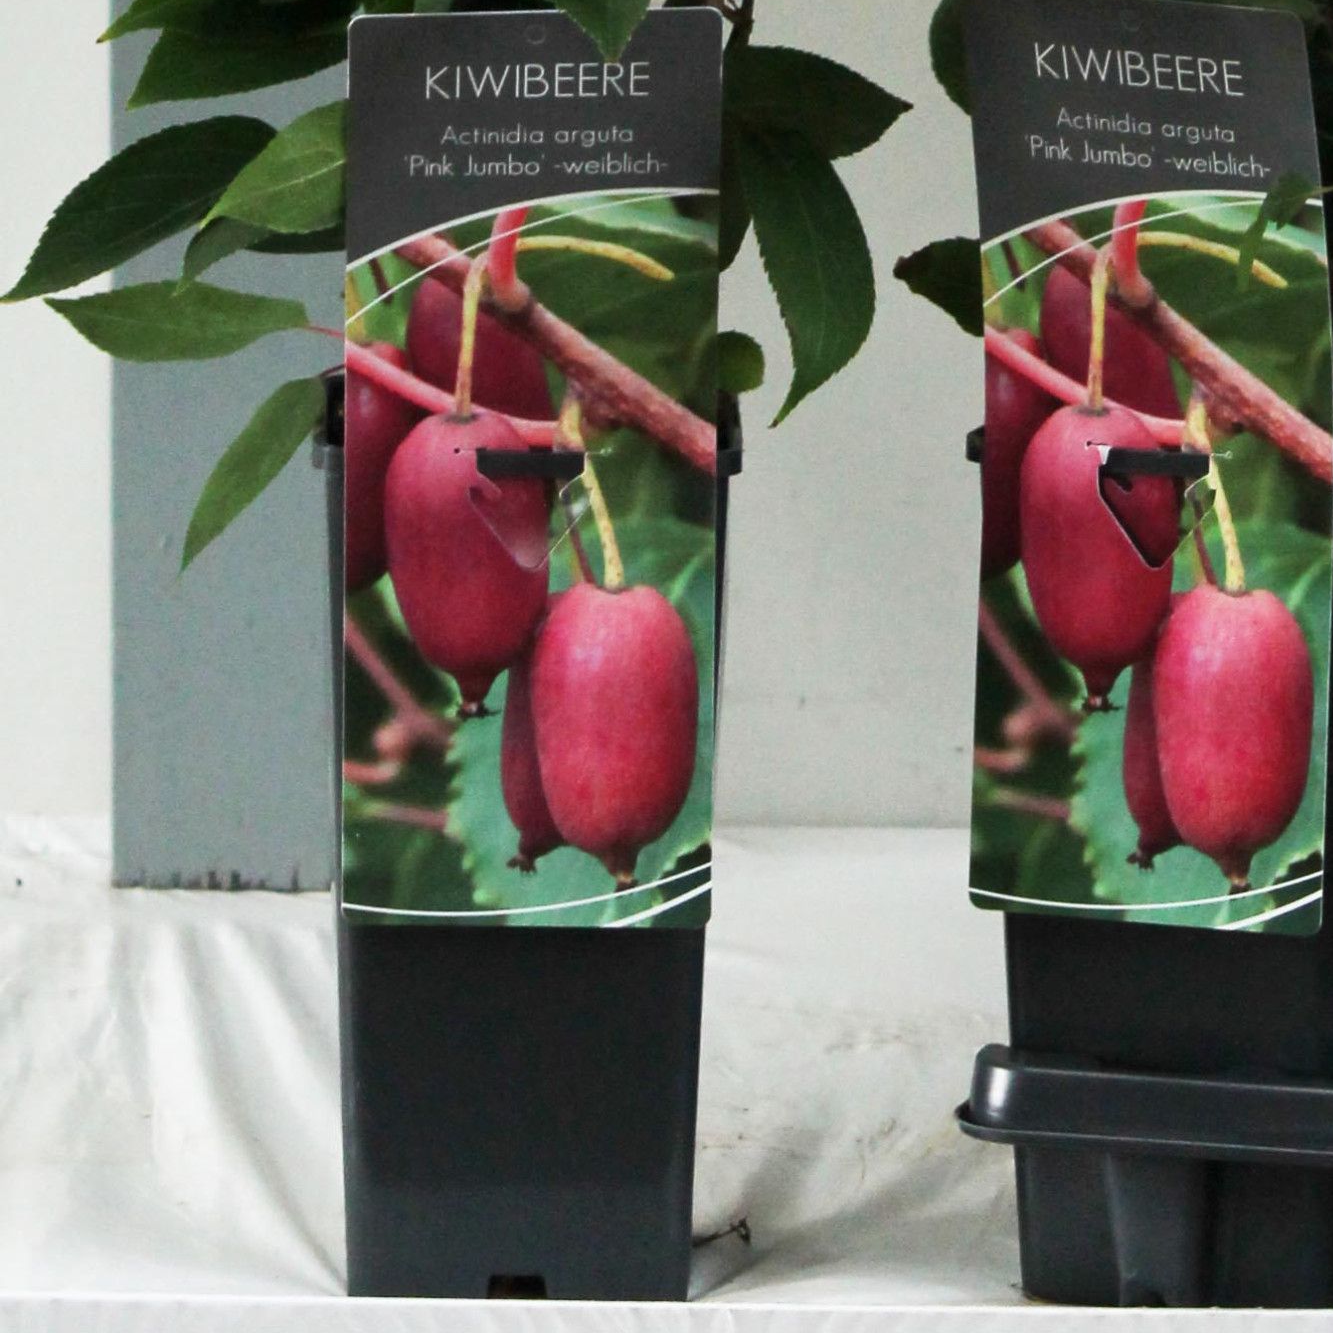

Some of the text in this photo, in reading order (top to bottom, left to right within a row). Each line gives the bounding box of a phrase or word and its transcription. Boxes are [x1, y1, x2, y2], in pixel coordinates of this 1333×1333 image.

[424, 61, 650, 100] KIWIBEERE
[1033, 41, 1245, 97] KIWIBEERE
[439, 122, 635, 148] Actinidia arguta
[1056, 107, 1236, 145] Actinidia arguta
[553, 151, 669, 175] -weiblich-
[1163, 150, 1272, 179] -weiblich-
